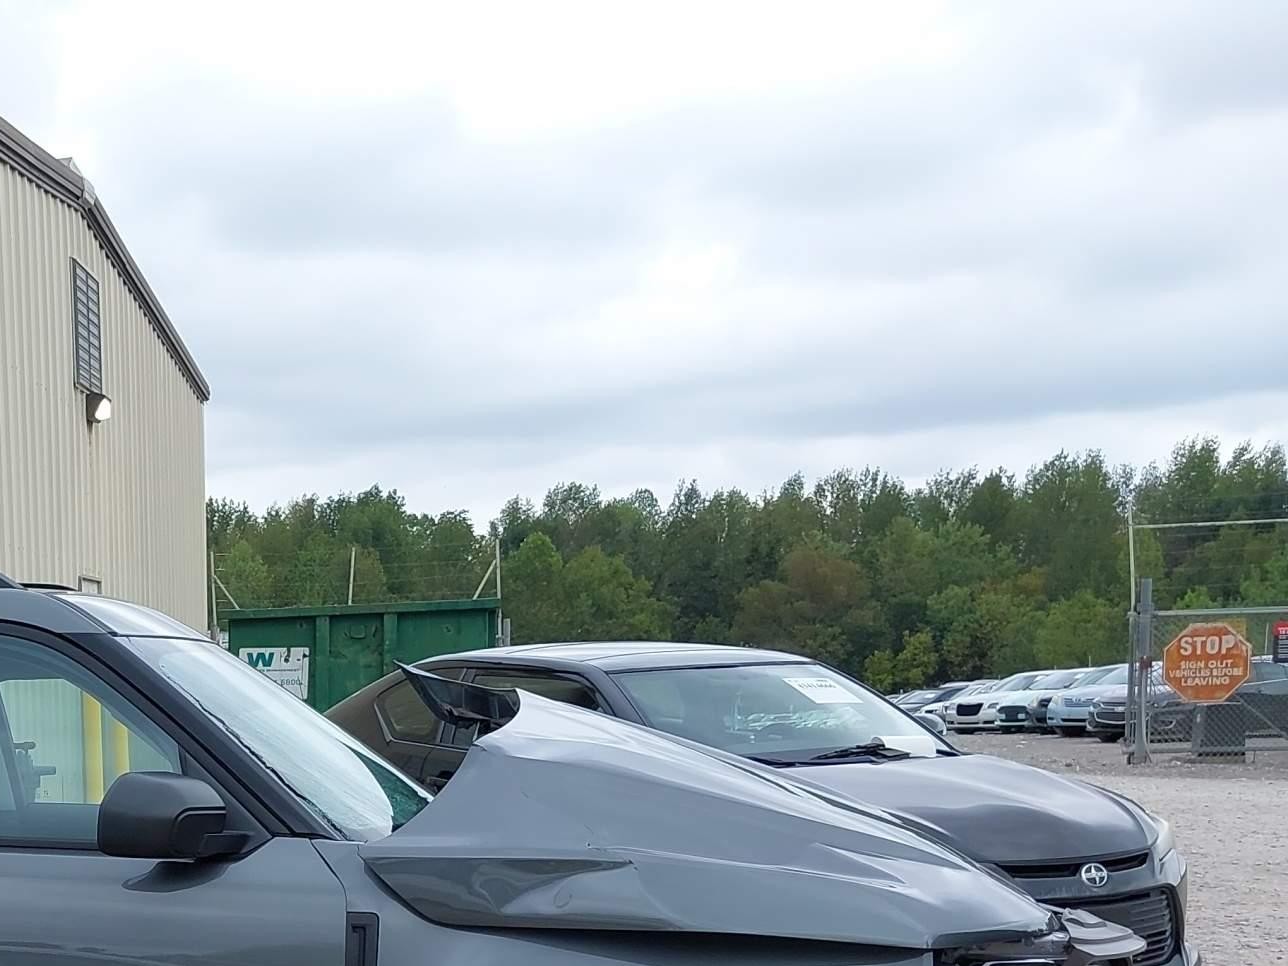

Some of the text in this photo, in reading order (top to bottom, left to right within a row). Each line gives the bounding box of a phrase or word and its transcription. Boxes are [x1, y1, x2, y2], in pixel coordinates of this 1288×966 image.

[1179, 634, 1236, 656] STOP
[1180, 659, 1234, 669] SIGN OUT
[1169, 667, 1244, 678] VEHICLES BEFORE
[1181, 676, 1230, 687] LEAVING
